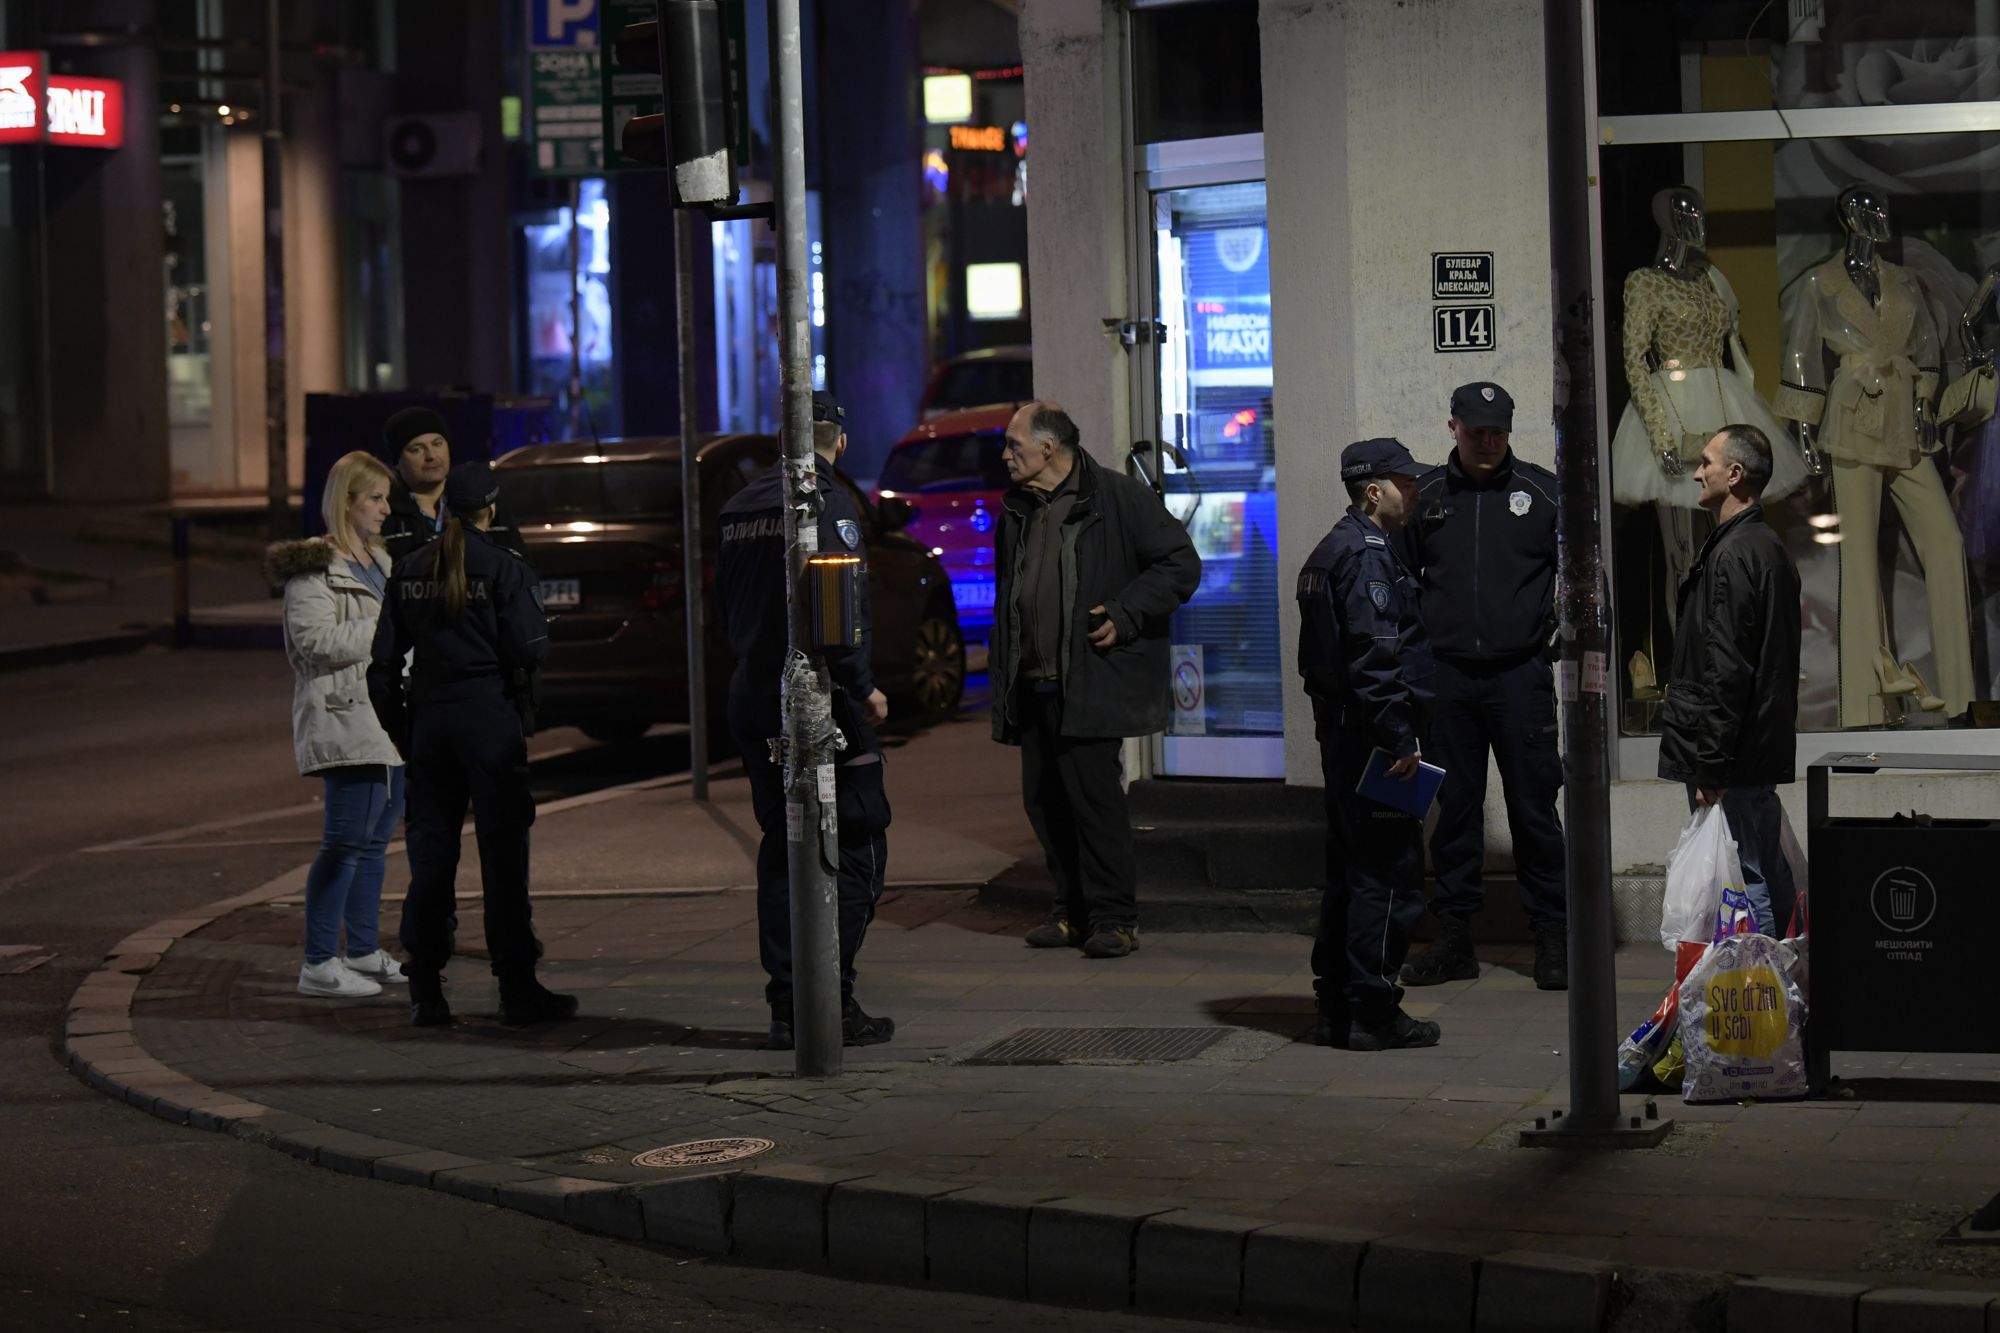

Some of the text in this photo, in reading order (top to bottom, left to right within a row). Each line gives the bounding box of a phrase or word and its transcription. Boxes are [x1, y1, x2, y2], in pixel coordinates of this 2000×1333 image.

[1446, 259, 1481, 268] БУЛЕВАР
[1449, 271, 1477, 280] КРАЉА
[1438, 282, 1489, 293] АЛЕКСАНДРА
[1440, 309, 1488, 345] 114
[401, 581, 488, 600] ПОЛИЈА
[1875, 940, 1933, 949] МЕШОВИТИ
[1887, 952, 1922, 962] ОТПАД
[1711, 982, 1778, 1013] Sve držim
[1712, 1013, 1752, 1041] u sebi
